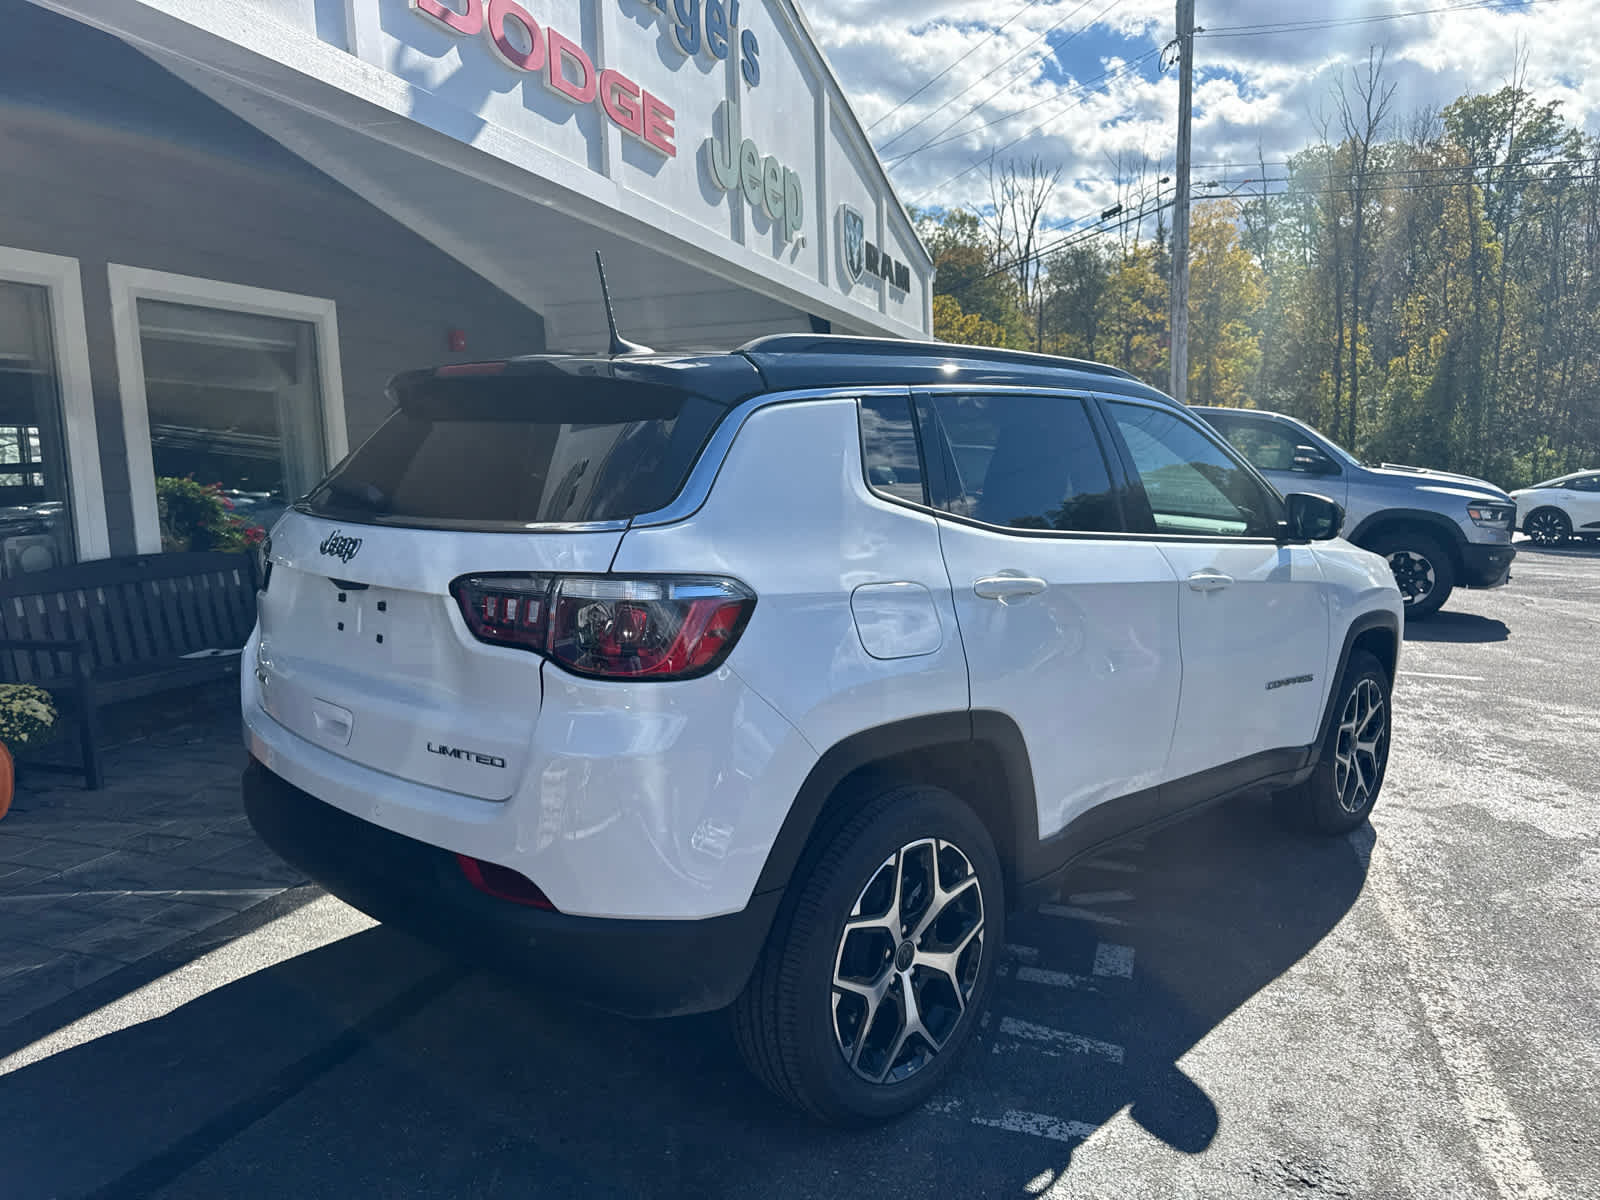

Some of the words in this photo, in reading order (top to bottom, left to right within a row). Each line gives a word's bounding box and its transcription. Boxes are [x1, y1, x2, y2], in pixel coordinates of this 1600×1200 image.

[655, 0, 760, 88] ge's
[711, 100, 803, 243] Jeep
[865, 240, 910, 294] RAM
[320, 529, 362, 563] Jeep
[1264, 673, 1314, 690] COMPASS
[426, 741, 506, 768] LIMITED
